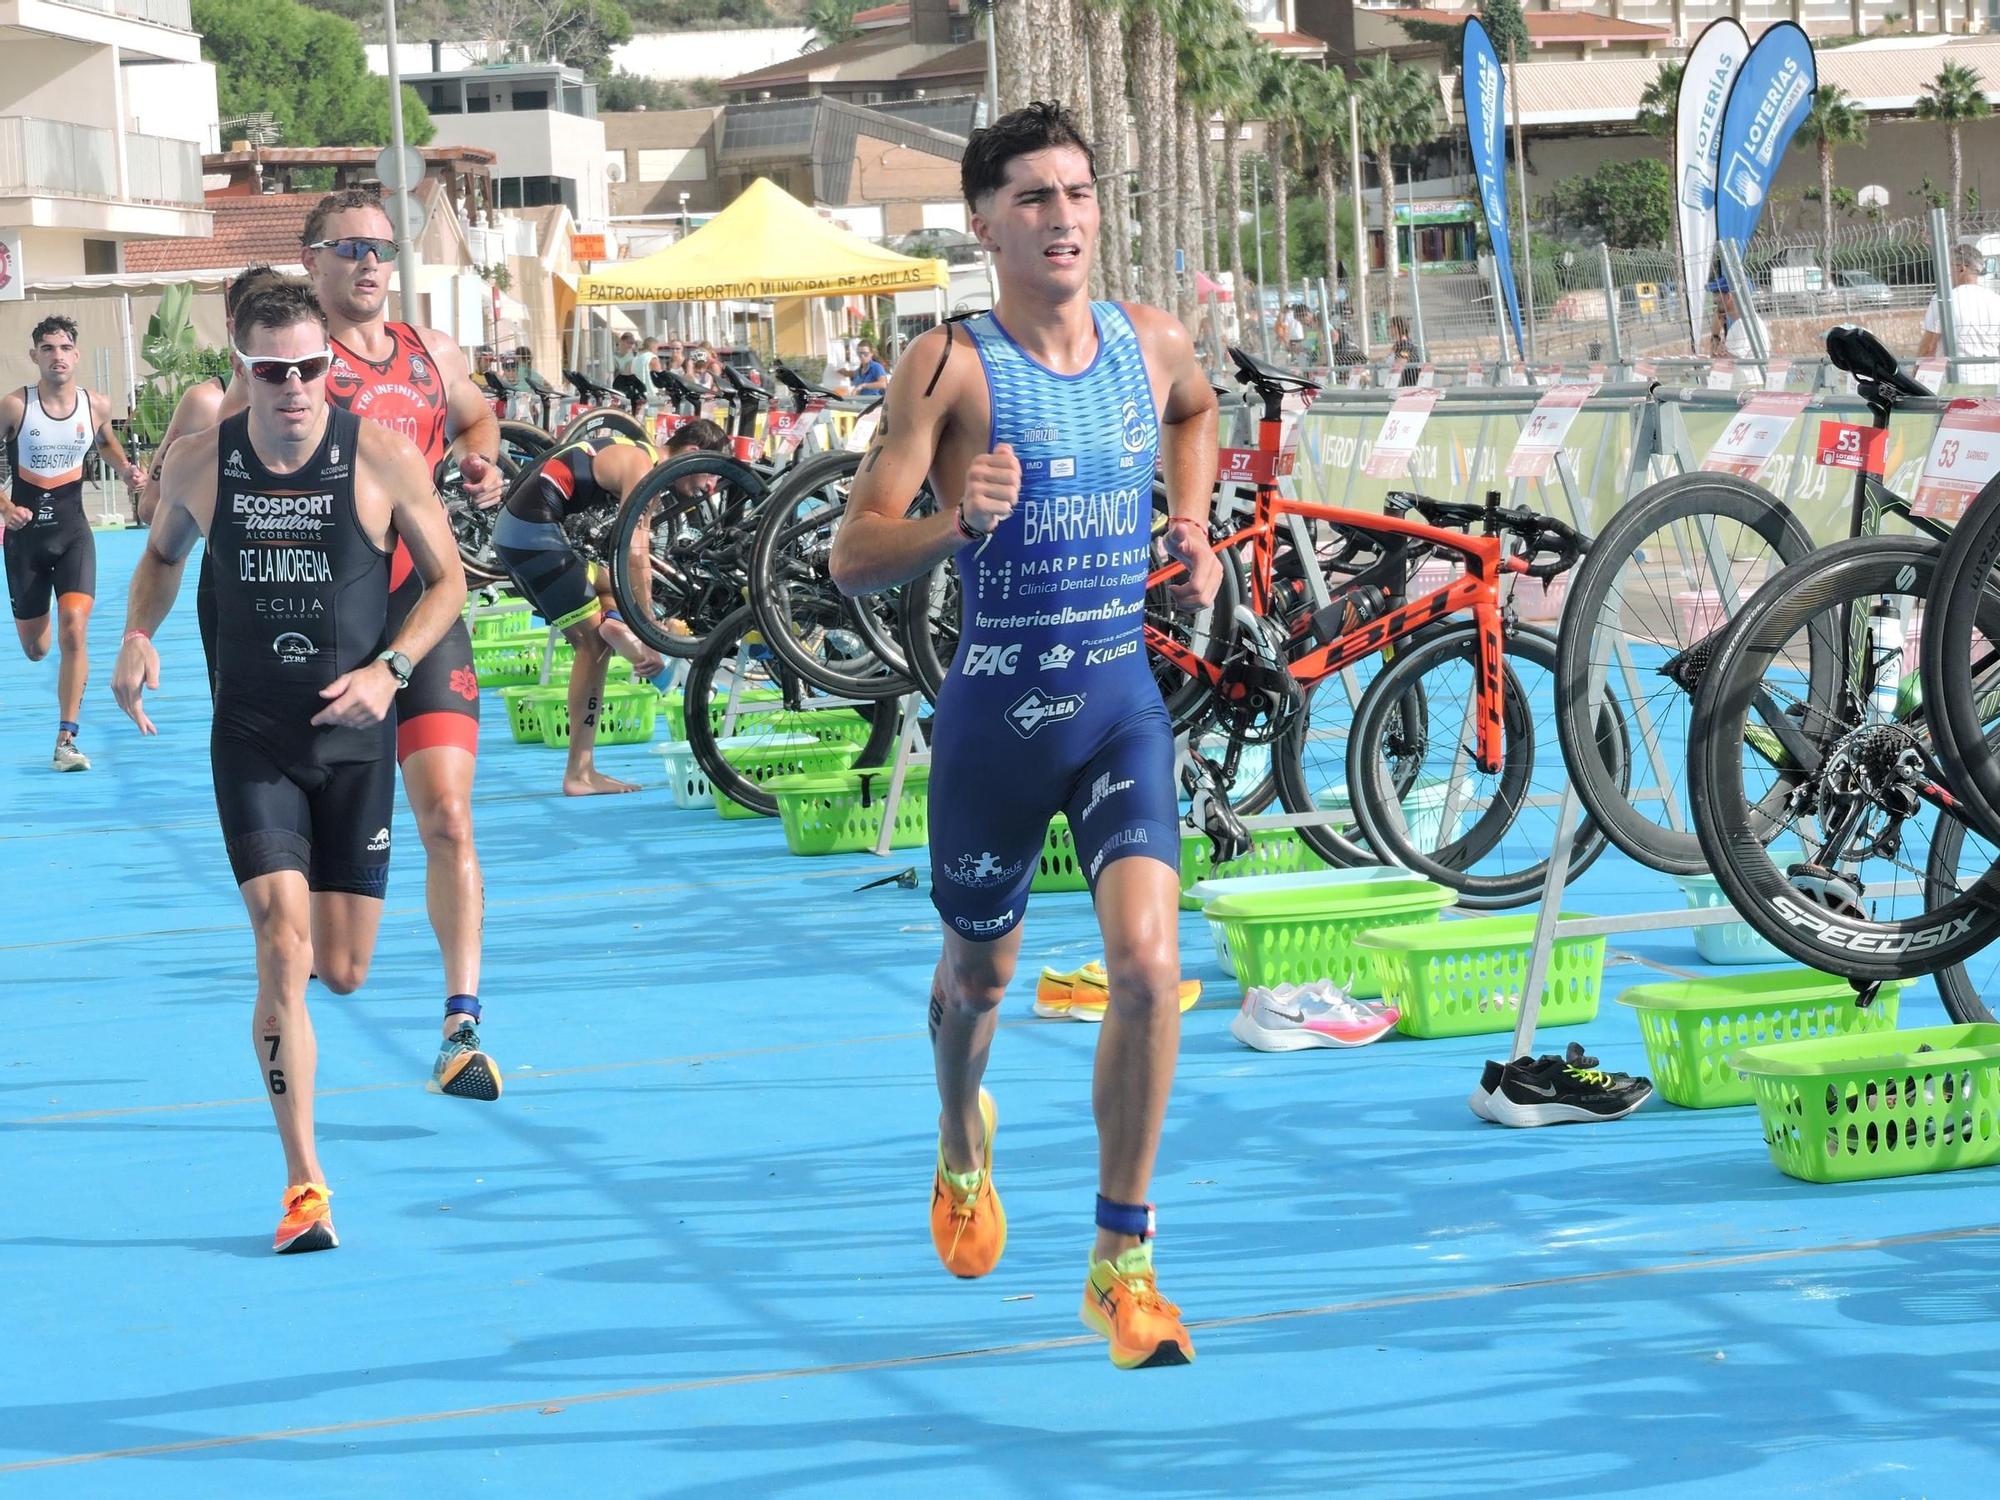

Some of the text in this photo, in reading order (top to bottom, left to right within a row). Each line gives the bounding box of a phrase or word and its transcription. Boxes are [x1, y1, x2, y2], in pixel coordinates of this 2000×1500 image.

[1696, 53, 1732, 160] LOTERÍAS
[1743, 56, 1797, 155] LOTERÍAS
[589, 284, 672, 300] PATRONATO
[676, 282, 756, 300] DEPORTIVO
[860, 268, 921, 286] AGUILAS
[356, 383, 426, 411] TRI INFINITY
[674, 418, 687, 429] 66
[778, 416, 791, 429] 63
[1528, 415, 1547, 437] 55
[1022, 428, 1059, 442] HORIZON
[1727, 422, 1752, 446] 54
[1837, 429, 1861, 452] 53
[30, 451, 77, 469] SEBASTIÁN
[1026, 461, 1043, 470] IMD
[1120, 456, 1134, 468] ADS
[1231, 453, 1251, 470] 57
[1937, 440, 1960, 469] 53
[233, 493, 334, 515] ECOSPORT
[1023, 488, 1139, 546] BARRANCO
[246, 531, 322, 541] ALCOBENDAS
[239, 549, 256, 582] DE
[276, 548, 333, 582] MORENA
[1019, 582, 1057, 596] Clínica
[1060, 576, 1097, 591] Dental
[1101, 572, 1118, 587] Los
[256, 598, 325, 613] ECIJA
[961, 643, 1023, 677] FAC
[972, 909, 1014, 931] EDM
[1771, 896, 1979, 954] SPEEDSIX
